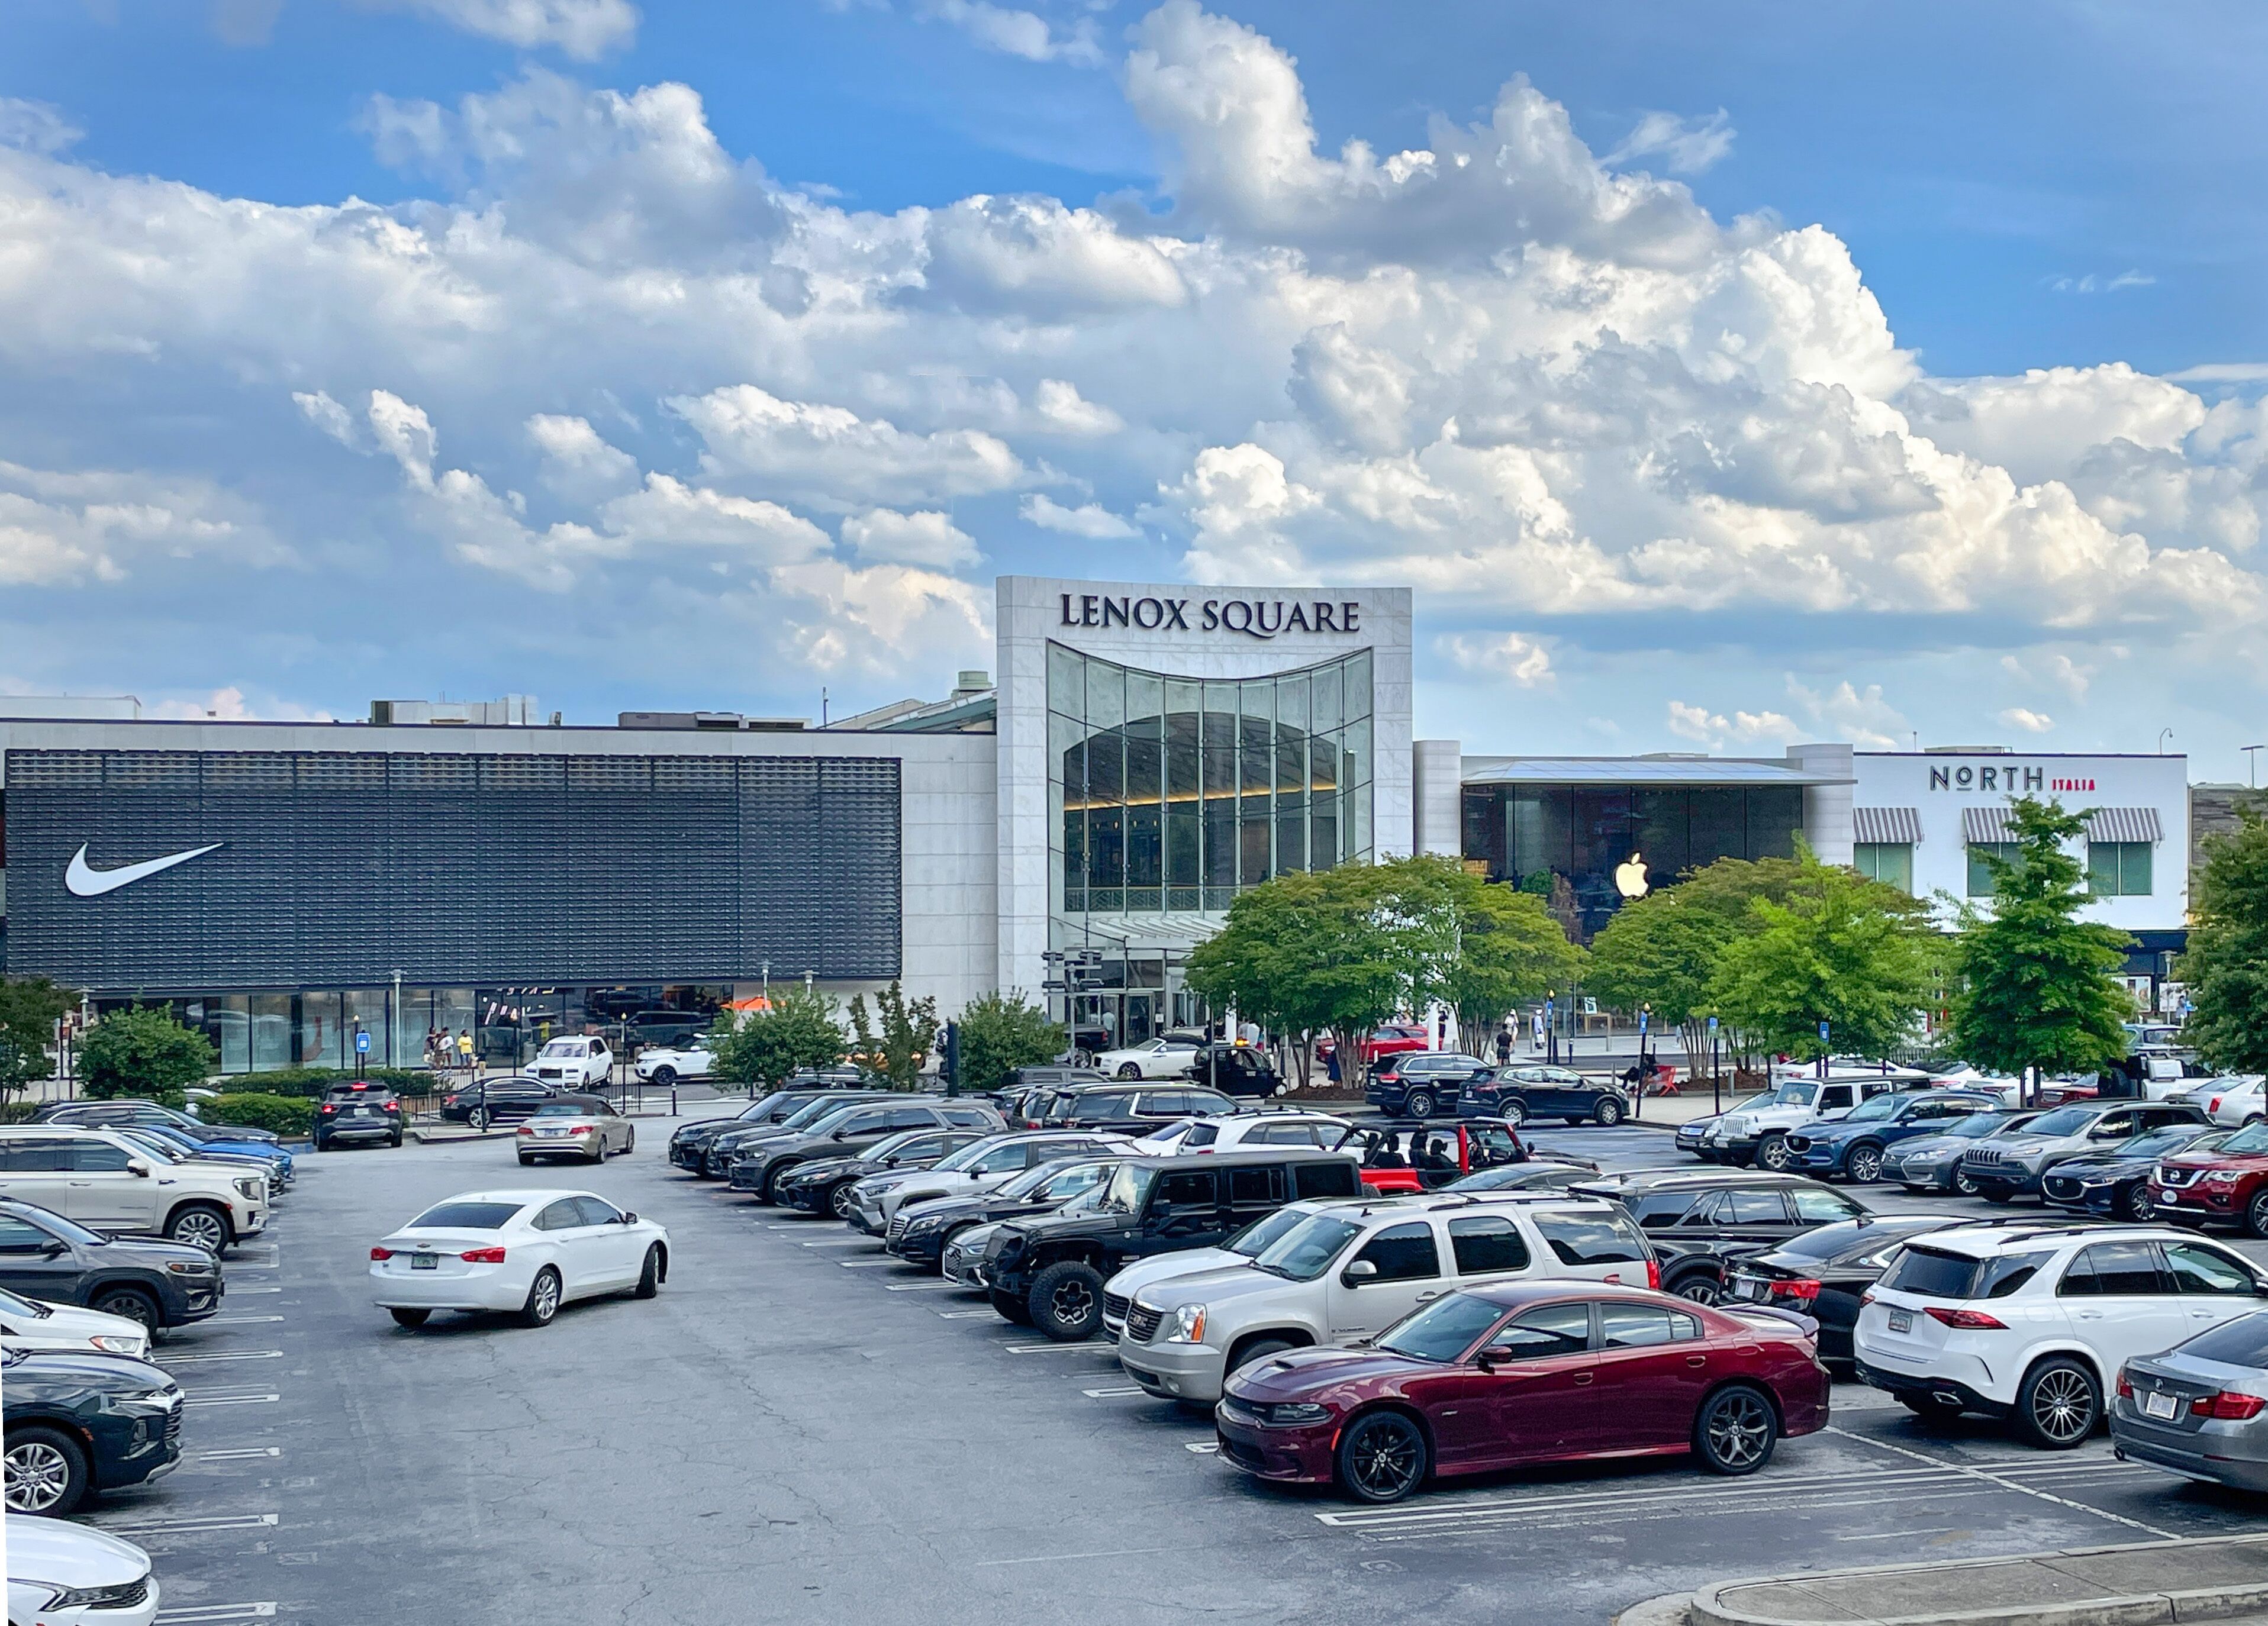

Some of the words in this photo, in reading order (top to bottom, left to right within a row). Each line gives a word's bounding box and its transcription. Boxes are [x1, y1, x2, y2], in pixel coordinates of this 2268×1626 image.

[1060, 593, 1191, 630] LENOX
[1201, 599, 1361, 639] SQUARE
[1929, 765, 2043, 791] NORTH
[2051, 779, 2096, 791] ITALIA
